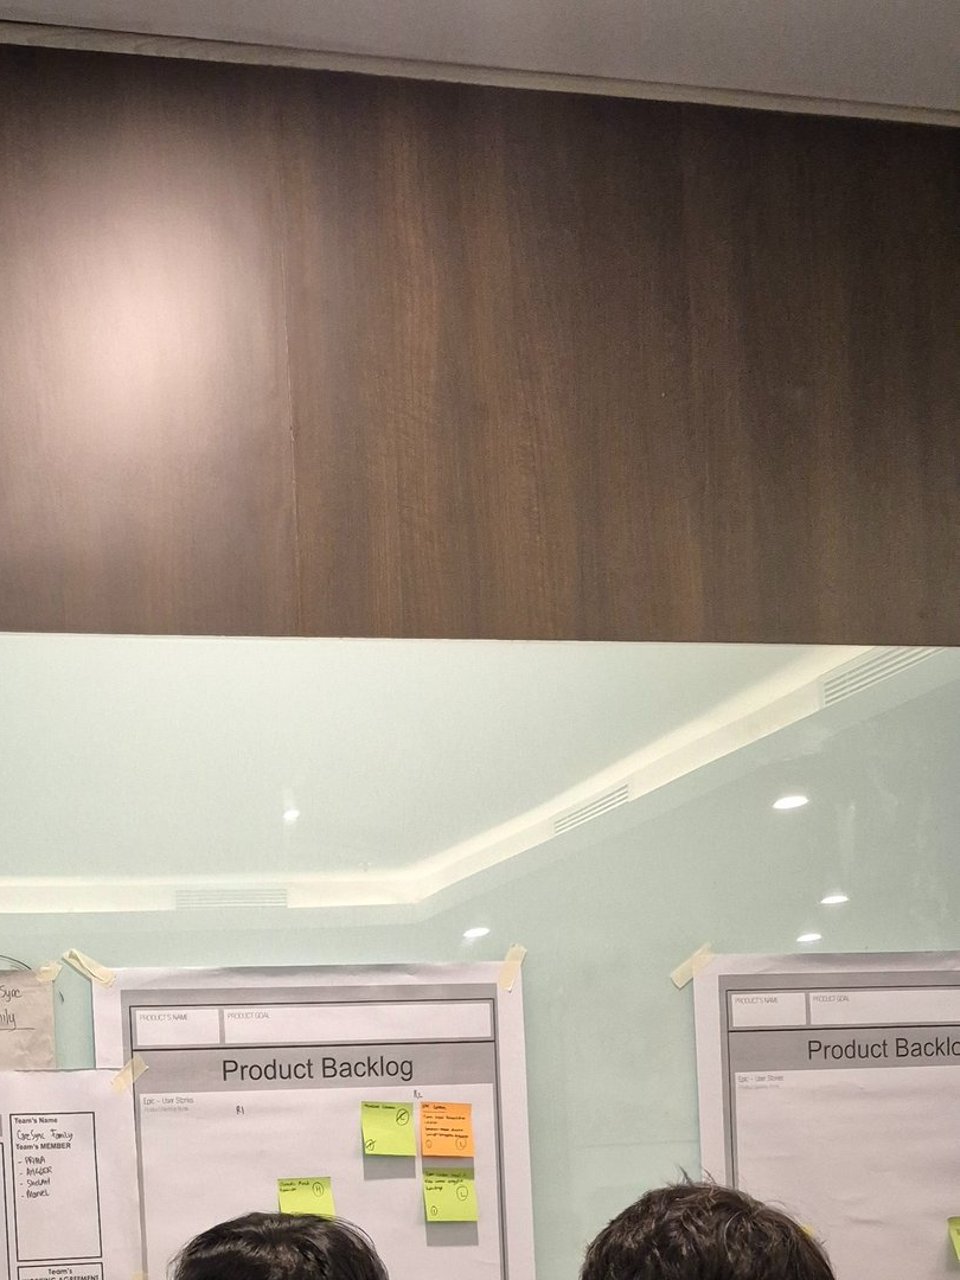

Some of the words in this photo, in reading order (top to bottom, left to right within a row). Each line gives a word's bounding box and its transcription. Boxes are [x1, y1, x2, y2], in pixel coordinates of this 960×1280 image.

[808, 1039, 888, 1060] Product
[896, 1036, 960, 1058] Backlo
[222, 1057, 313, 1081] Product
[322, 1055, 414, 1081] Backlog
[48, 1268, 72, 1276] Team's
